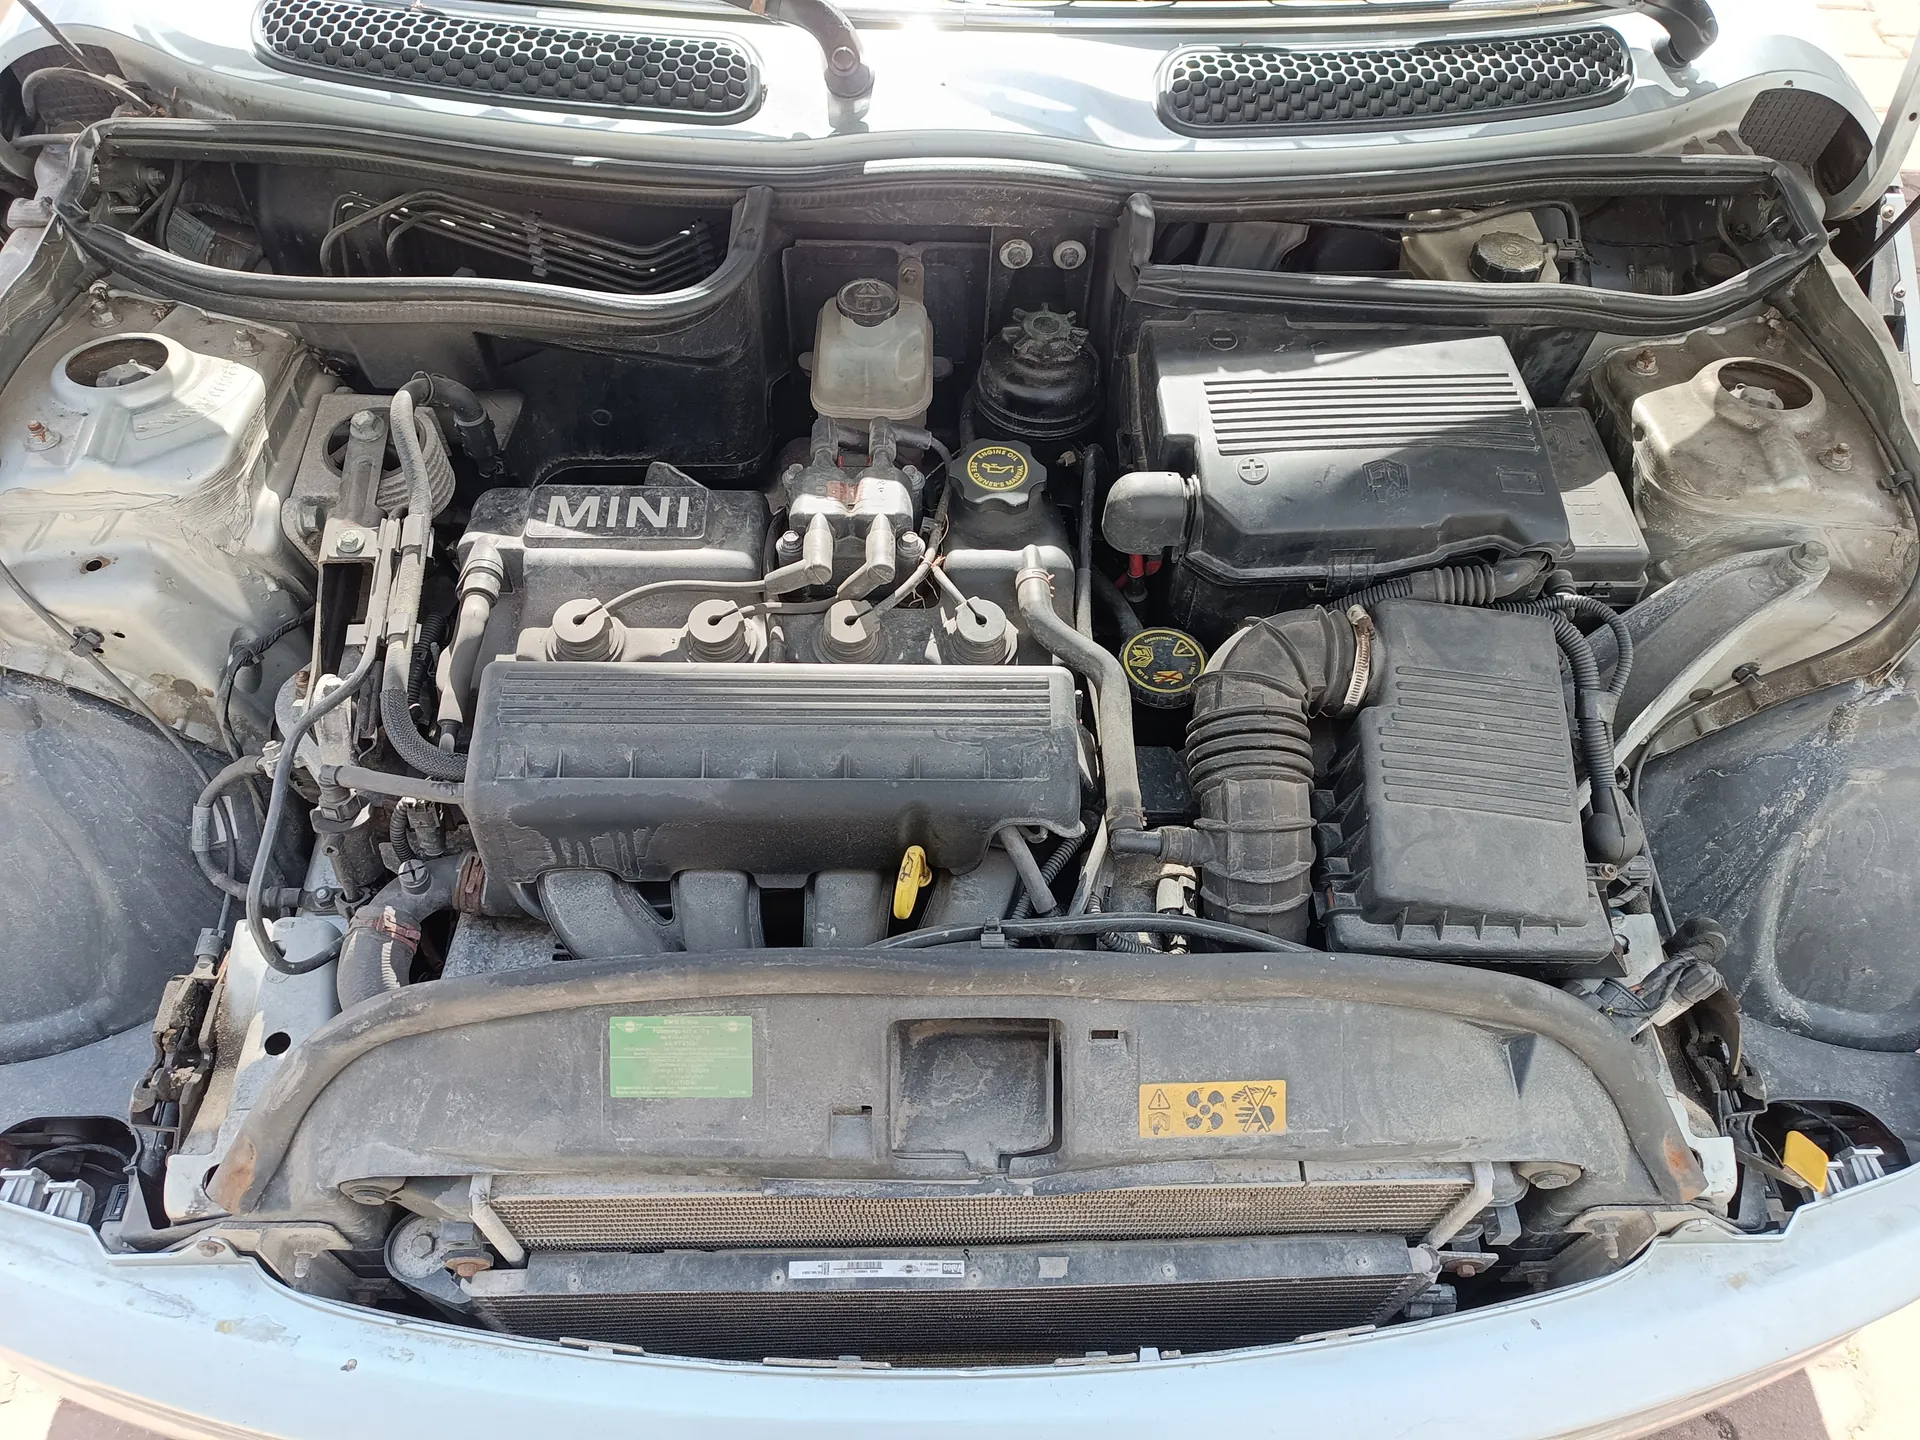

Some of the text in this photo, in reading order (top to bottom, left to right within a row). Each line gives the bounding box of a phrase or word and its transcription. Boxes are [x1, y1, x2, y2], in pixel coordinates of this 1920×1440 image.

[977, 449, 1019, 462] ENGINE OIL
[974, 473, 1005, 488] OWNER'S
[1005, 465, 1024, 486] MANUAL
[545, 495, 690, 528] MINI
[943, 1264, 962, 1273] Valeo
